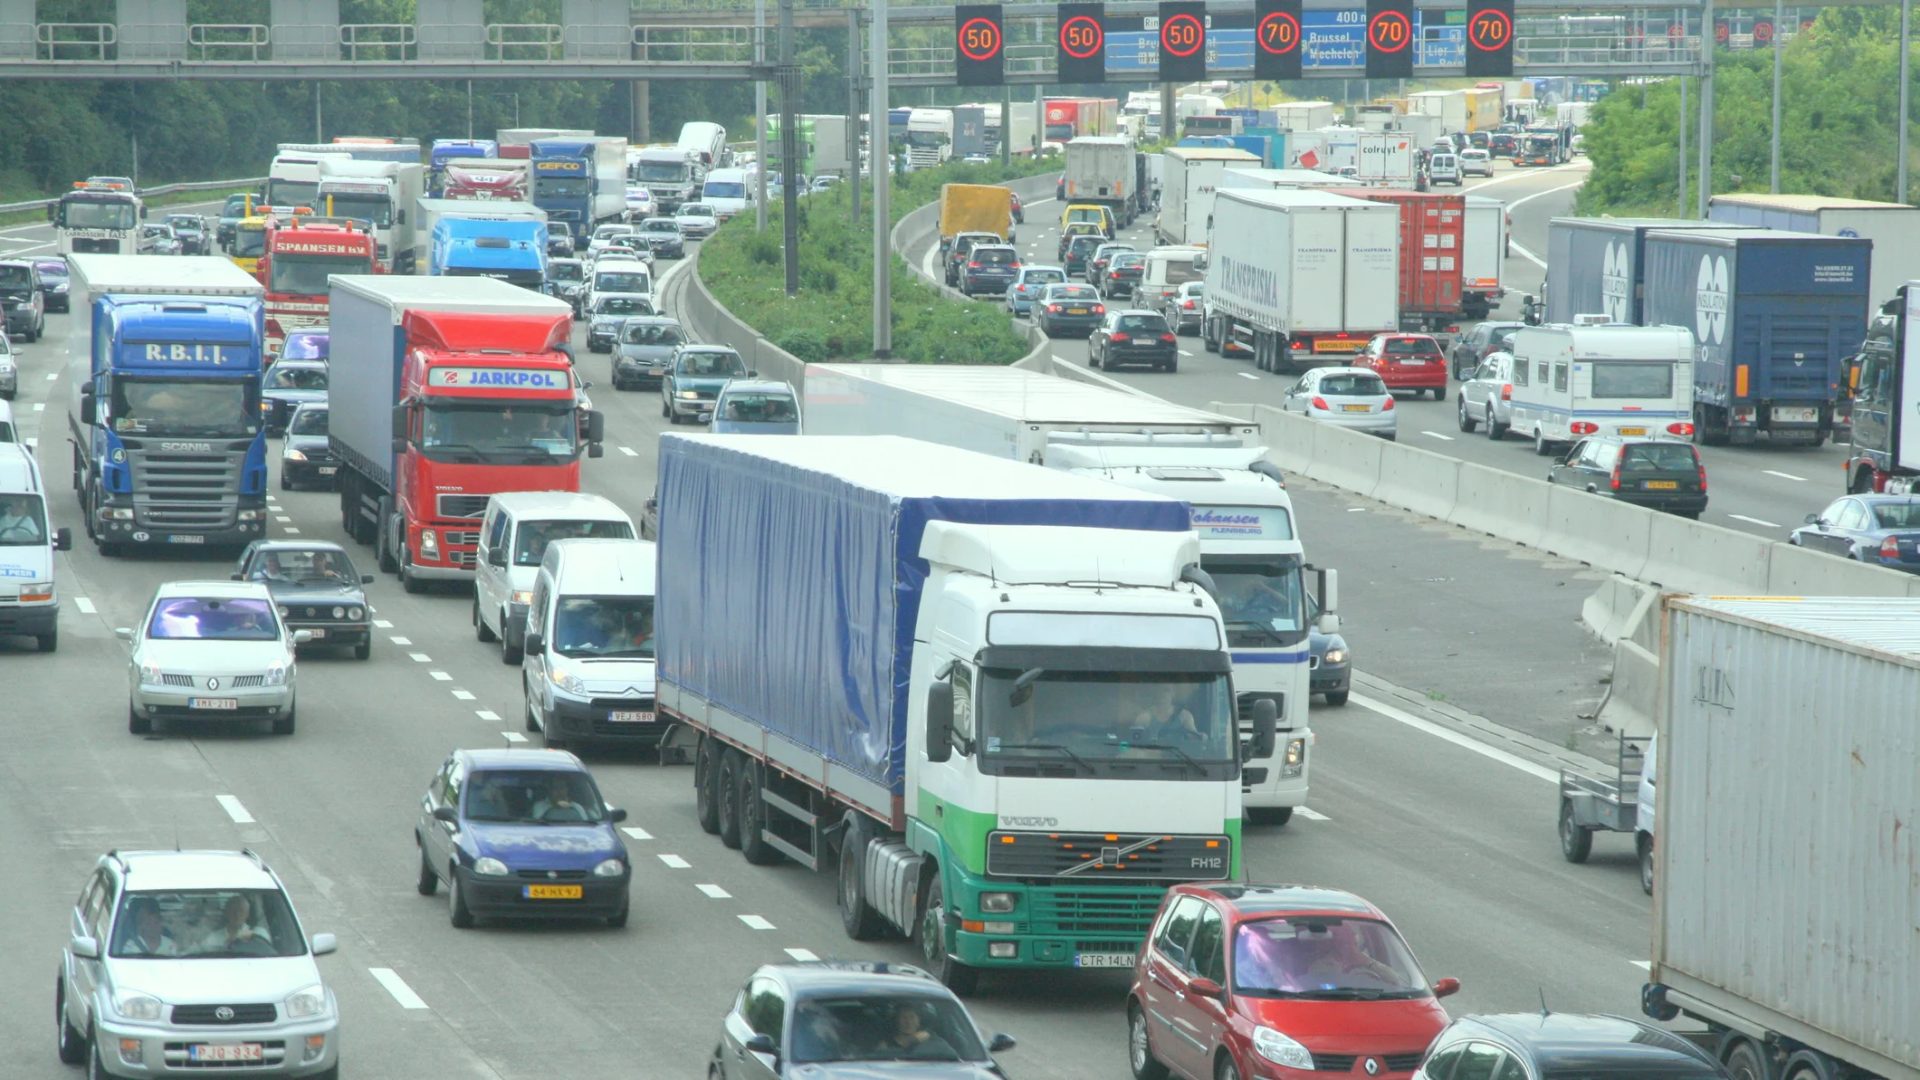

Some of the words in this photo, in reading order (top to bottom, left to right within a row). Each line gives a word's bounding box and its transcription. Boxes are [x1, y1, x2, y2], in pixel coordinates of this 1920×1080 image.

[1336, 11, 1358, 23] 400
[1170, 25, 1194, 44] 50
[1267, 24, 1291, 43] 70
[1378, 22, 1402, 41] 70
[1479, 20, 1502, 39] 70
[967, 29, 992, 48] 50
[1069, 27, 1093, 46] 50
[1309, 32, 1350, 43] Brussel
[1309, 48, 1359, 59] Mechelen
[537, 162, 580, 170] GEFCO
[277, 242, 346, 253] SPAANSEN
[1221, 256, 1278, 308] TRANSPRISMA
[470, 371, 555, 387] JARKPOL
[161, 442, 212, 452] SCANIA
[113, 451, 123, 461] 4
[1000, 816, 1058, 827] VOLVO
[1191, 857, 1222, 868] FH12
[1081, 955, 1105, 966] CTR
[1109, 955, 1134, 966] 14LN
